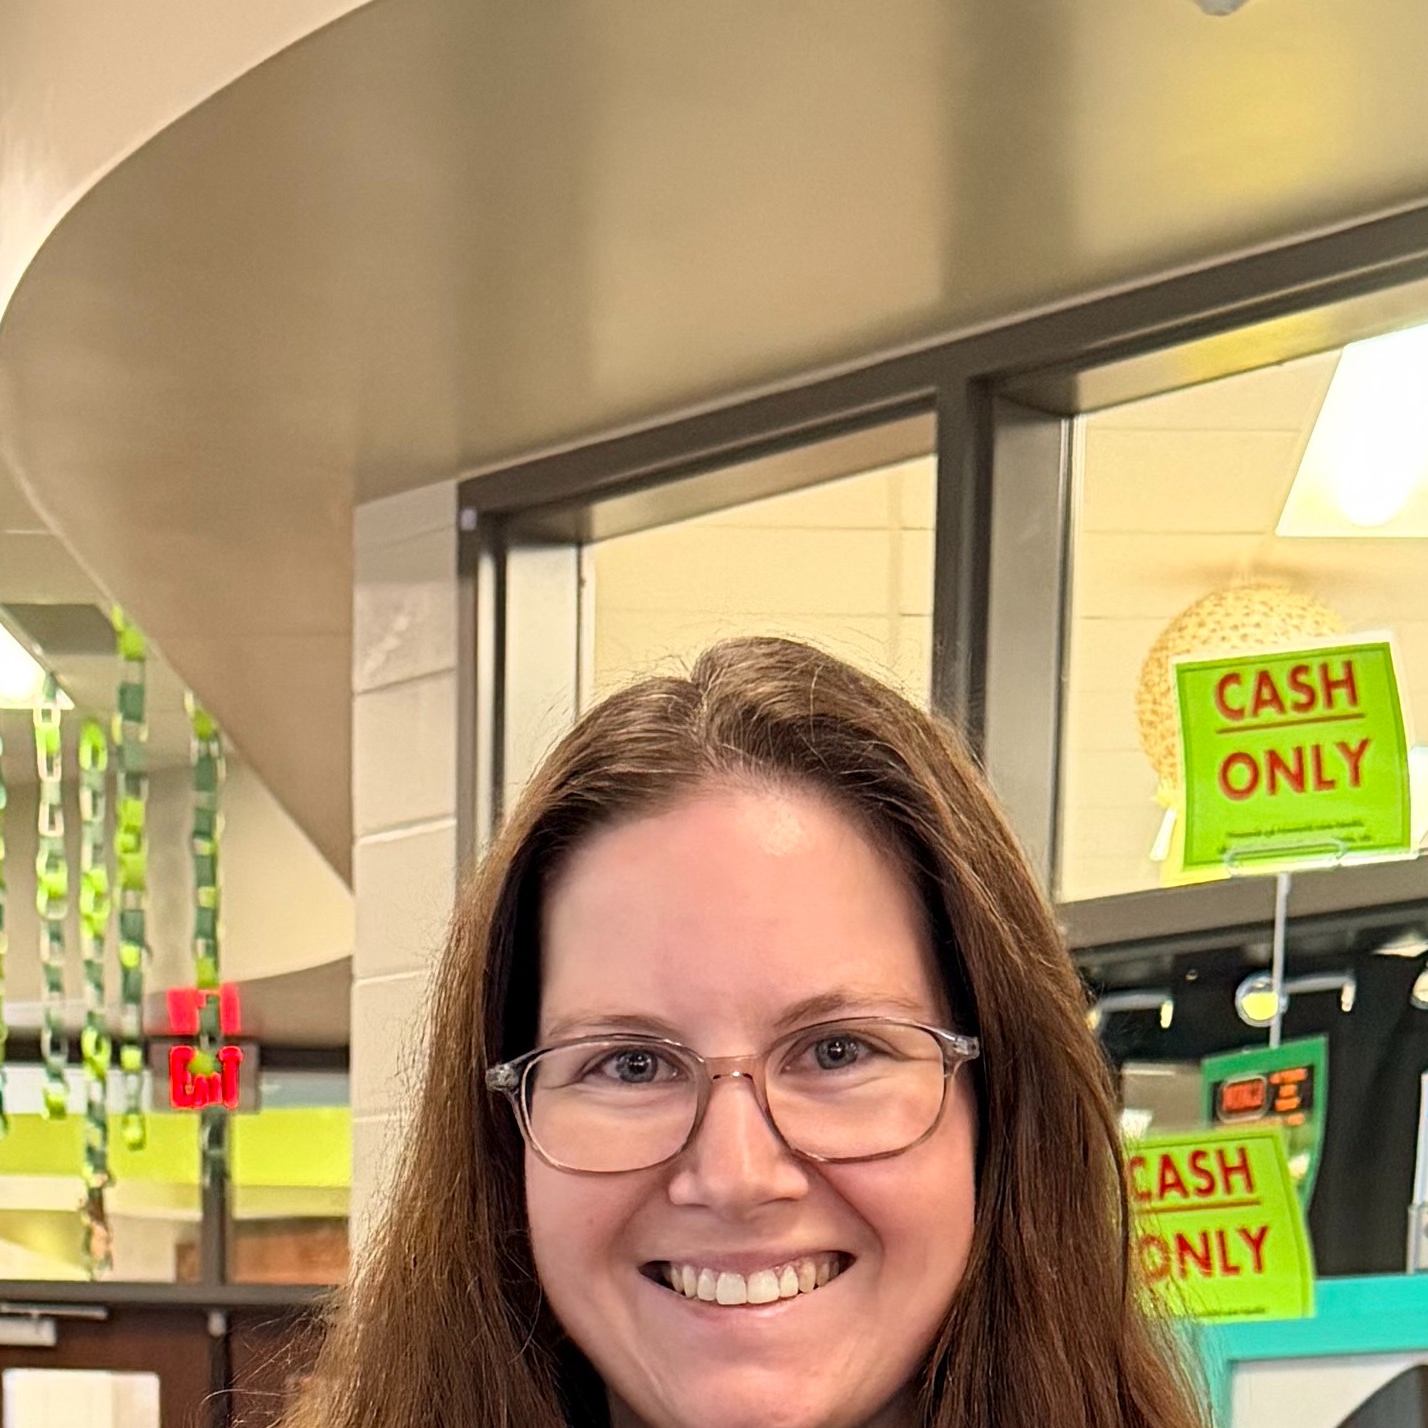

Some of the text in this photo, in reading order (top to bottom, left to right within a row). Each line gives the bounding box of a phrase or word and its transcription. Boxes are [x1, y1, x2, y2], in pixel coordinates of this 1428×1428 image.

[1214, 660, 1358, 721] CASH
[1219, 738, 1371, 801] ONLY
[1126, 1147, 1254, 1201] CASH
[1138, 1226, 1269, 1284] ONLY
